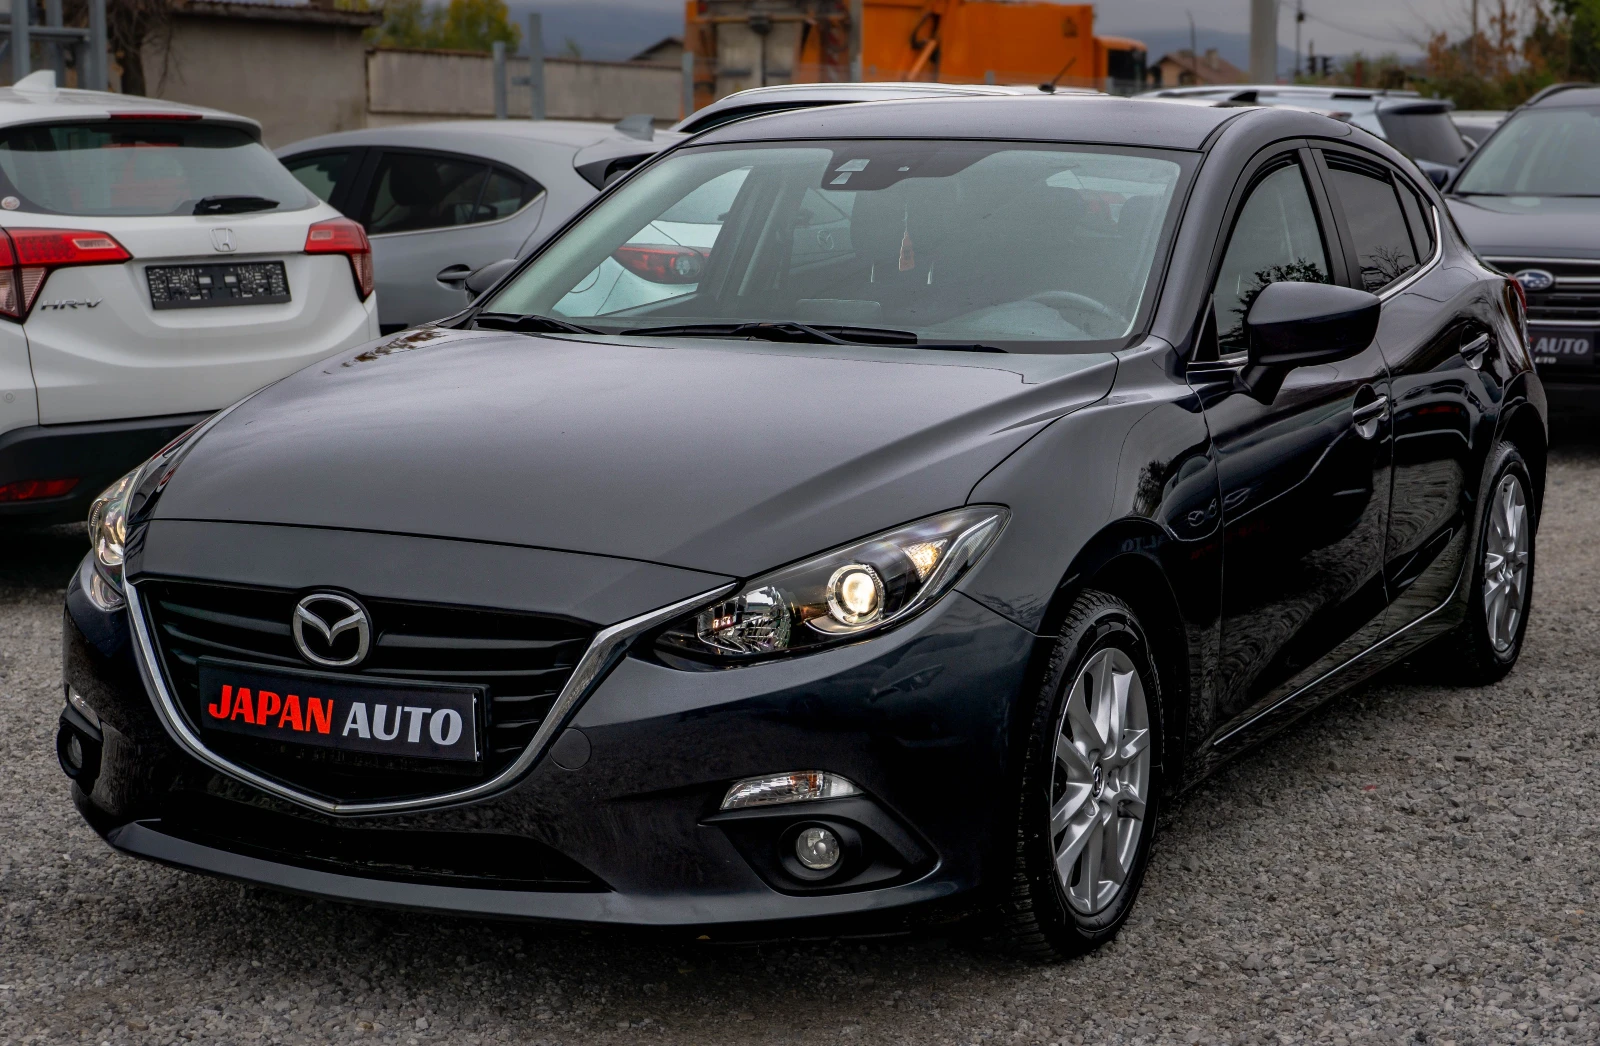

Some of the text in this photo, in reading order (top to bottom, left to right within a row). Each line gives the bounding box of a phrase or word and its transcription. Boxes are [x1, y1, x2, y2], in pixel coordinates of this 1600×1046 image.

[41, 298, 103, 311] HR-V
[1535, 337, 1589, 355] AUTO
[208, 684, 463, 746] JAPAN AUTO
